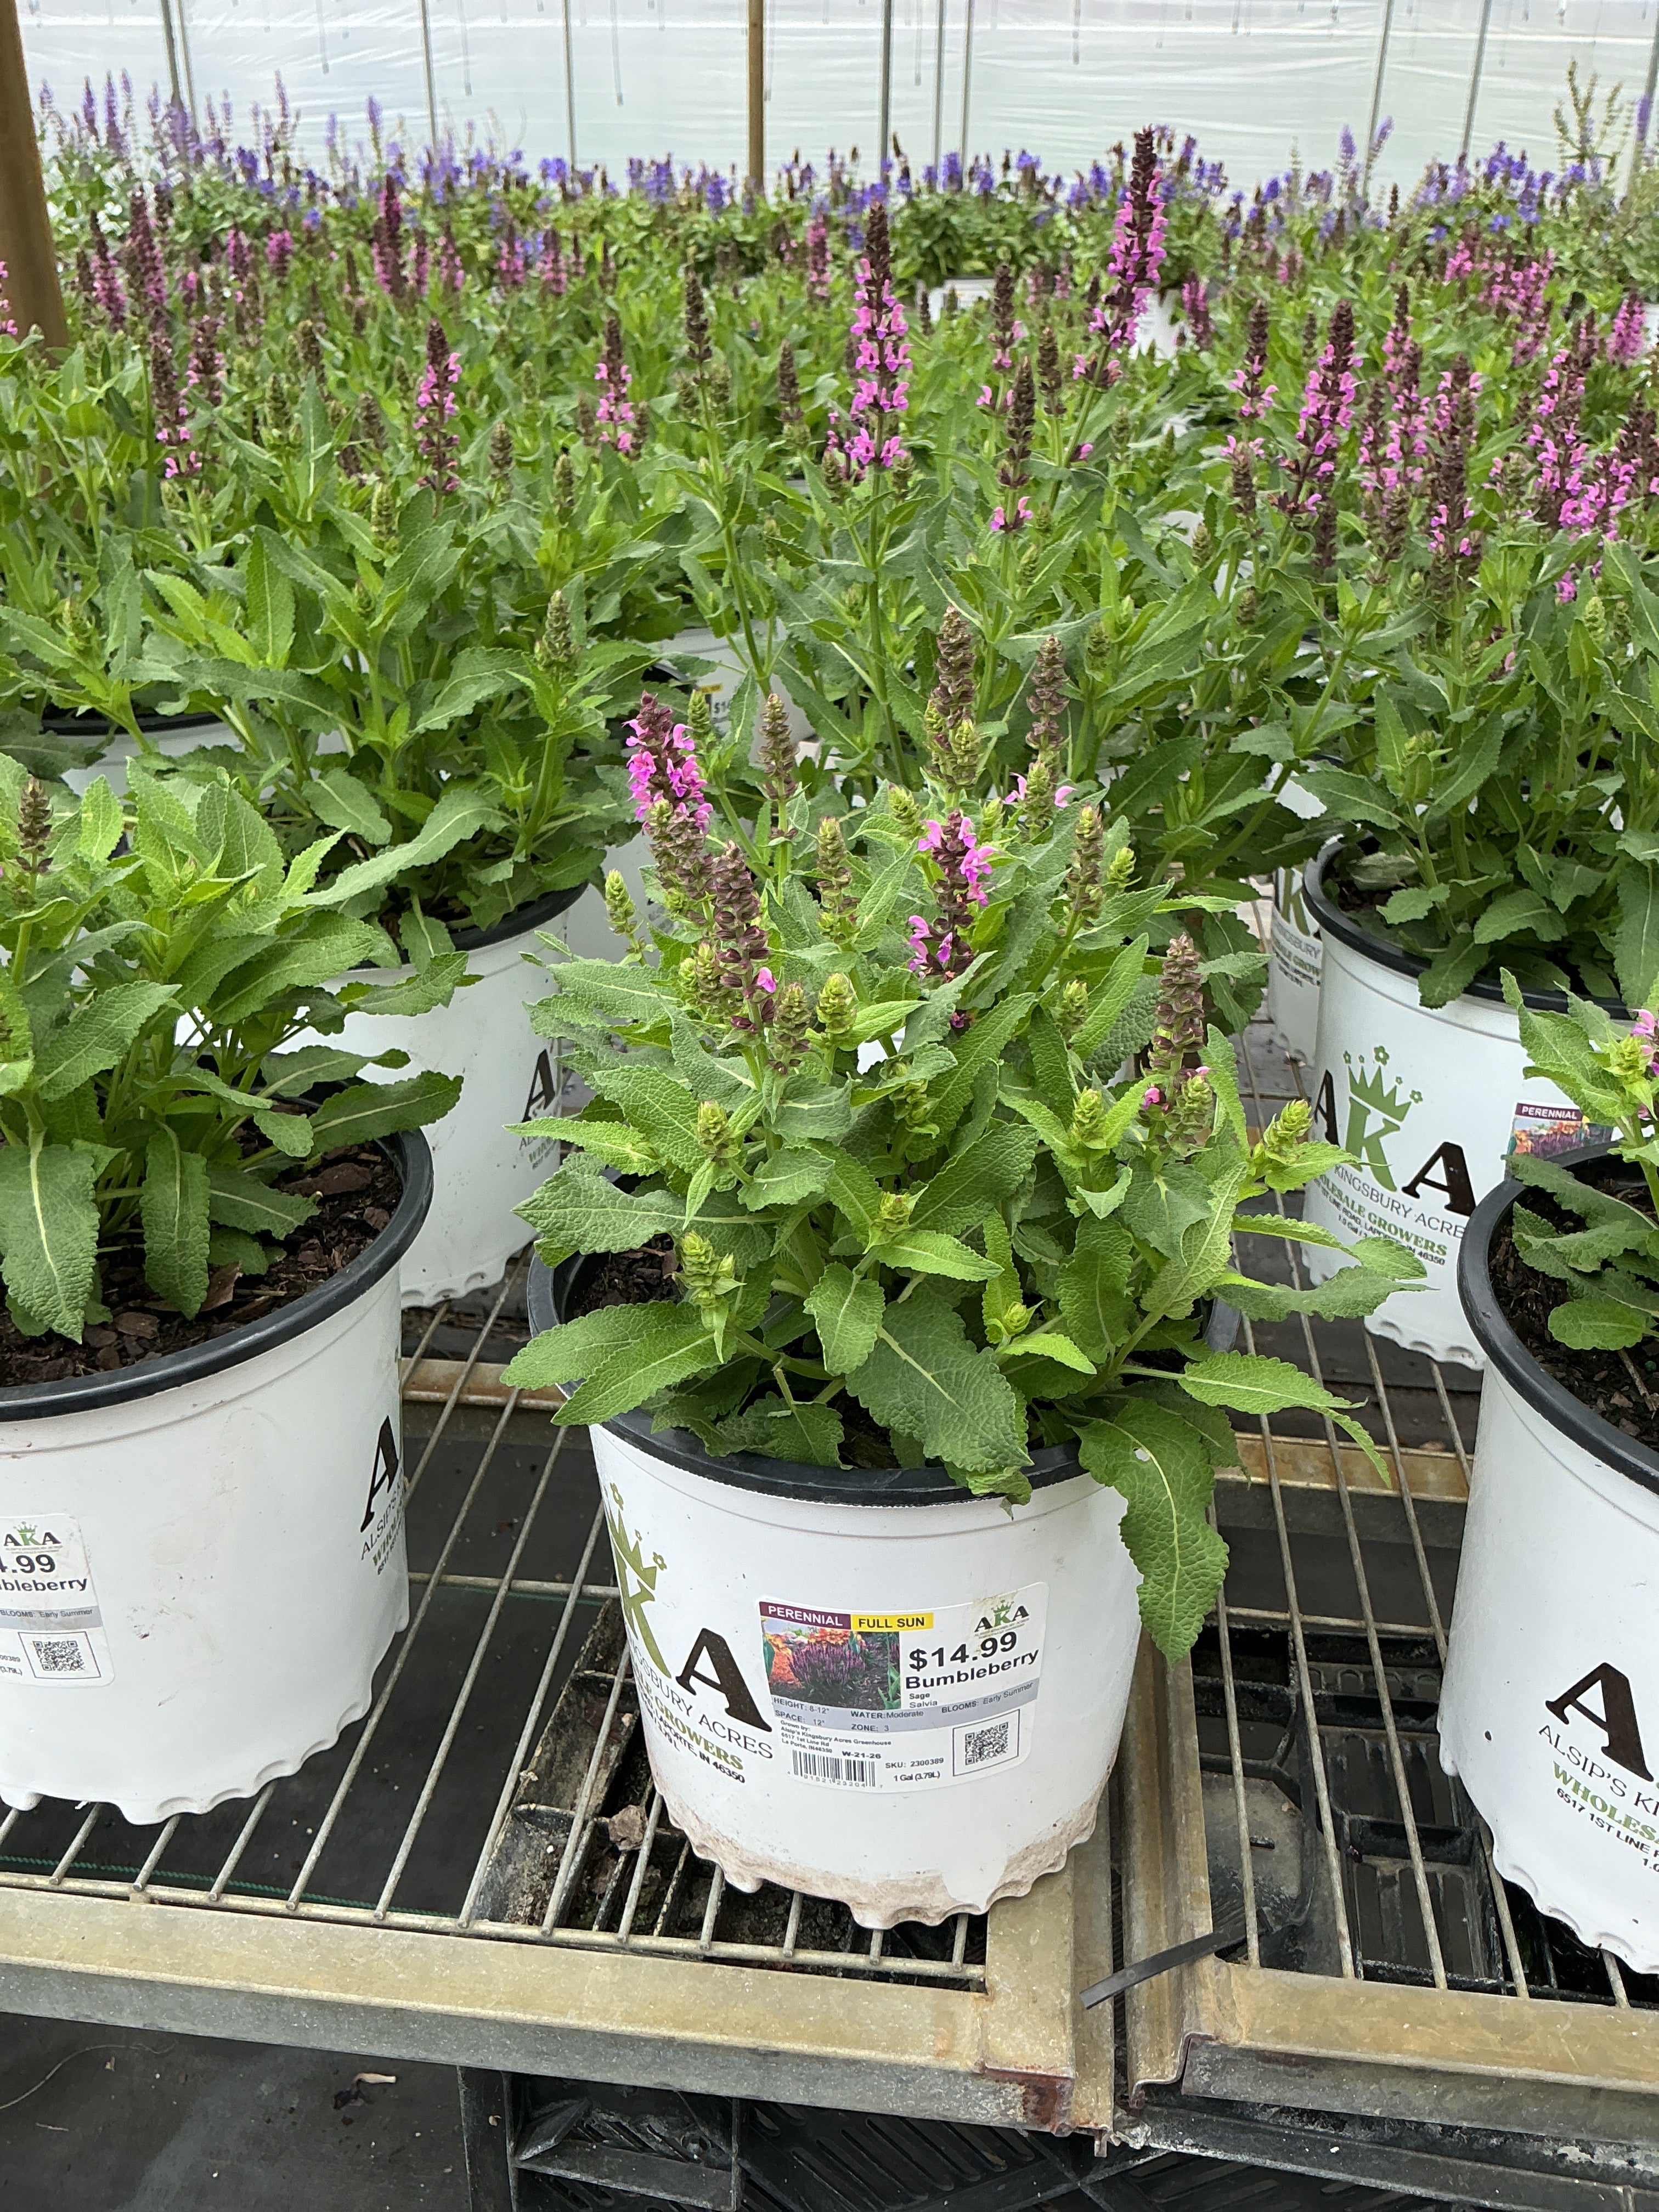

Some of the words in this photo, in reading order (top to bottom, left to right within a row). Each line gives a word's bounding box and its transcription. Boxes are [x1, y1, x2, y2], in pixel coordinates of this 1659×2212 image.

[1521, 1105, 1578, 1120] PERENNIAL
[1368, 1212, 1448, 1256] GROWERS
[1414, 1212, 1465, 1239] ACRE
[3, 1531, 62, 1547] AKA
[0, 1578, 88, 1592] bleberry
[60, 1609, 93, 1617] Summer
[768, 1605, 844, 1627] PERENNIAL
[858, 1618, 893, 1628] FULL
[896, 1616, 925, 1628] SUN
[974, 1605, 1030, 1633] AKA
[909, 1631, 1017, 1672] $14.99
[905, 1649, 1040, 1689] Bumbleberry
[774, 1697, 808, 1711] HEIGHT:
[941, 1701, 979, 1714] BLOOMS:
[983, 1693, 1002, 1705] Early
[1003, 1682, 1034, 1697] Summer
[909, 1692, 930, 1700] Sage
[909, 1700, 938, 1708] Salvia
[775, 1709, 806, 1723] SPACE:
[851, 1723, 879, 1732] ZONE:
[780, 1720, 800, 1729] Grown
[654, 1695, 743, 1770] GROWERS
[698, 1713, 774, 1759] ACRES
[781, 1726, 801, 1736] Alsip's
[802, 1731, 833, 1742] Kingsbury
[790, 1741, 808, 1749] Porte,
[842, 1750, 882, 1759] W-21-26
[699, 1750, 710, 1765] IN
[712, 1761, 746, 1784] 46350
[885, 1761, 906, 1769] SKU:
[910, 1757, 944, 1768] 2300389
[1538, 1724, 1628, 1797] ALSIP'S
[900, 1773, 914, 1781] Gal
[915, 1770, 941, 1782] (3.79L)
[1556, 1787, 1586, 1813] 6517
[1589, 1812, 1615, 1833] 1ST
[1616, 1830, 1651, 1854] LINE
